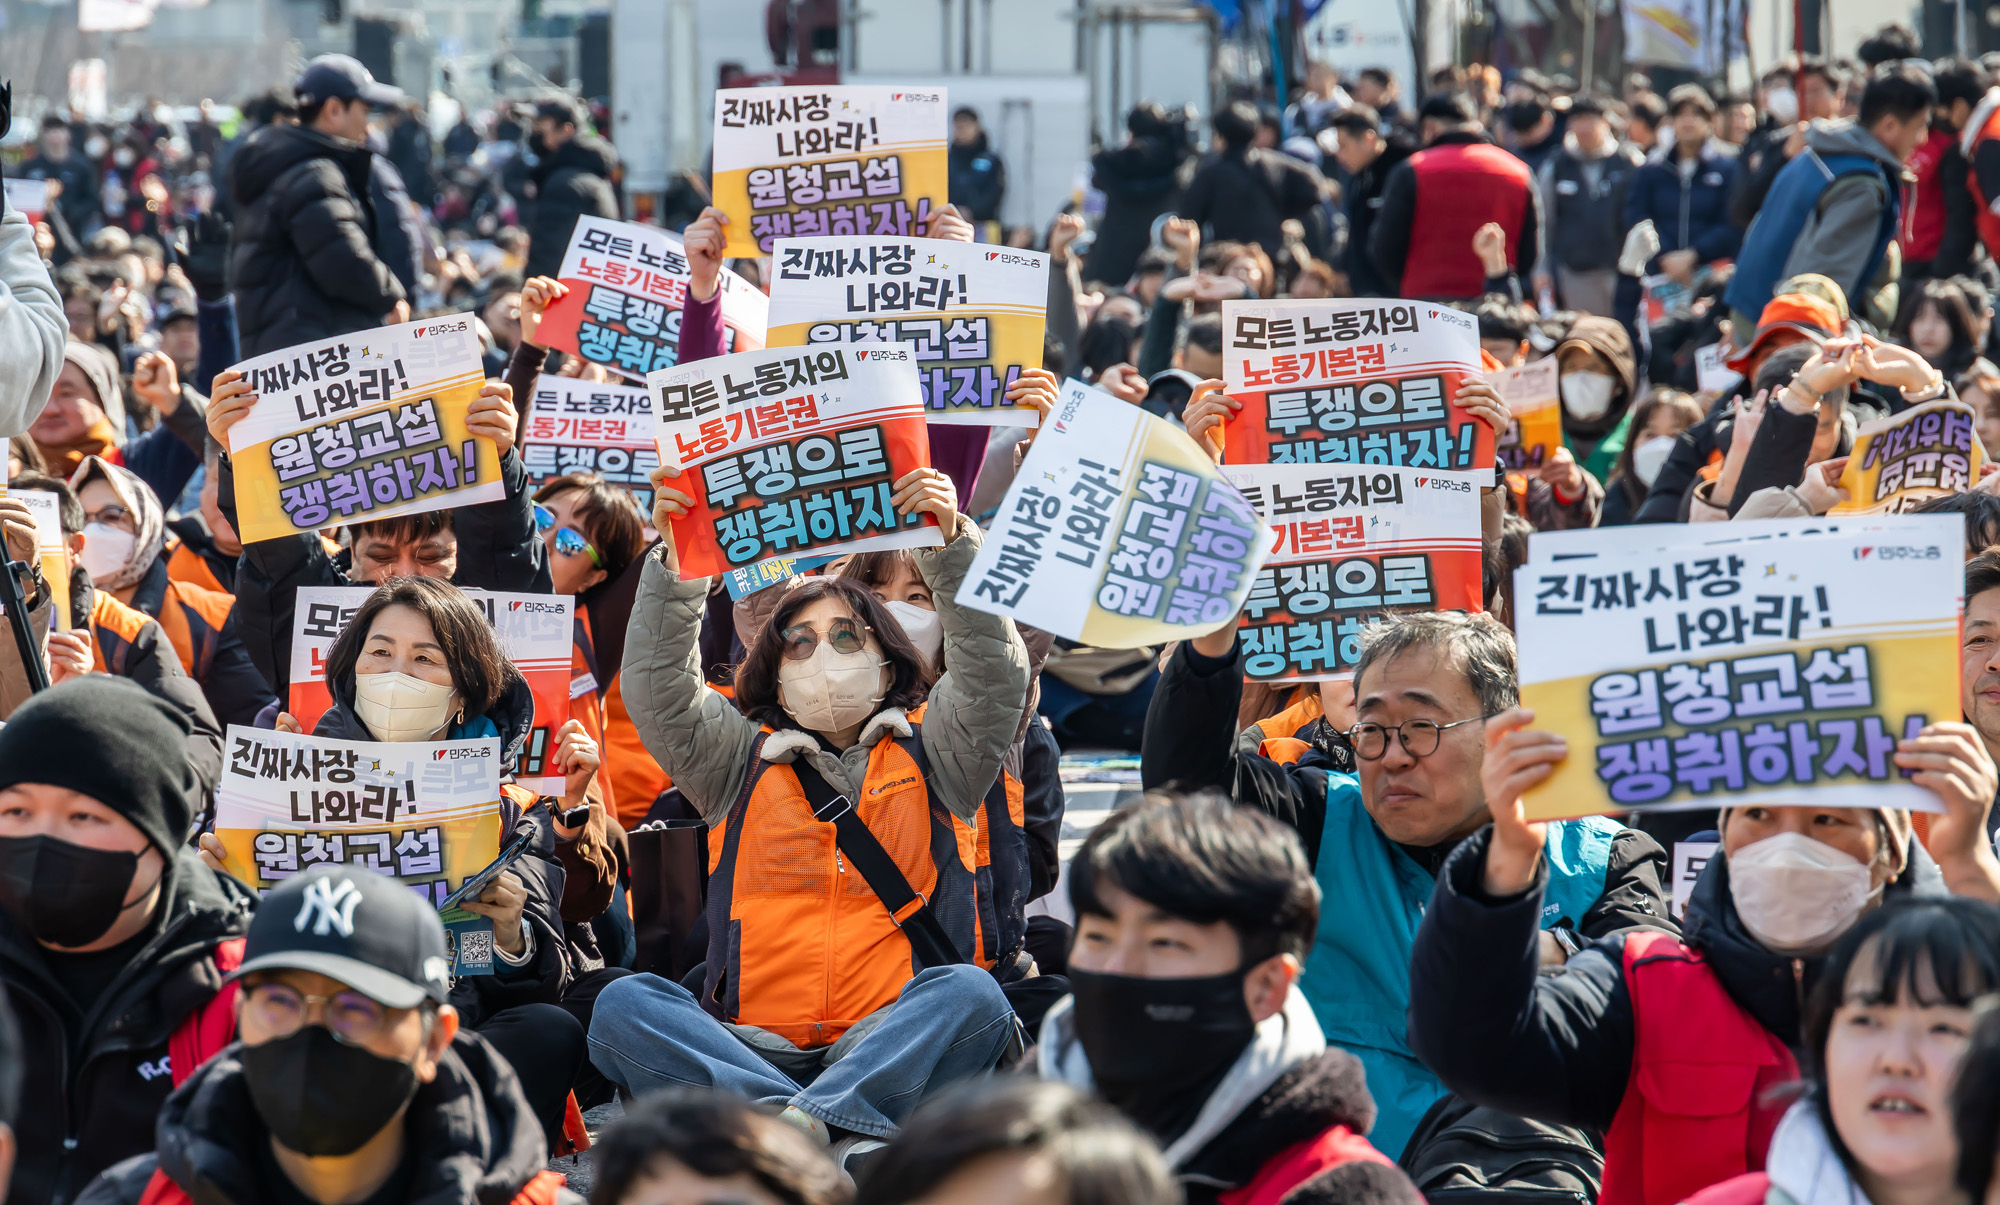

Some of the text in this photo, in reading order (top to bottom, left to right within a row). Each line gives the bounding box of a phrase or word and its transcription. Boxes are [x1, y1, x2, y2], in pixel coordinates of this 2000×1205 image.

[722, 93, 832, 128] 진짜사장
[904, 93, 940, 103] 민주노총
[777, 117, 880, 157] 나와라!
[747, 155, 900, 209] 원청교섭
[577, 227, 634, 261] 모든
[780, 244, 916, 280] 진짜사장
[1000, 252, 1041, 269] 민주노총
[846, 274, 968, 313] 나와라!
[428, 321, 467, 337] 민주노총
[1232, 305, 1420, 350] 모든 노동자의
[1440, 311, 1472, 330] 민주노총
[870, 350, 908, 362] 민주노총
[1242, 342, 1387, 388] 노동기본권
[295, 358, 410, 422] 나와라!
[534, 391, 558, 411] 든
[661, 348, 849, 423] 모든 노동자의
[1059, 390, 1086, 423] 민주노총
[1265, 375, 1448, 436] 투쟁으로
[268, 397, 443, 484] 원청교섭
[674, 394, 821, 464] 노동기본권
[279, 438, 478, 528] 쟁취하자!
[700, 424, 890, 511] 투쟁으로
[1431, 478, 1471, 493] 민주노총
[1055, 457, 1123, 569] 나와라!
[1272, 472, 1404, 515] 노동자의
[973, 485, 1062, 609] 진짜사장
[1098, 460, 1200, 619] 원청교섭
[1270, 515, 1367, 555] 기본권
[1878, 545, 1941, 561] 민주노총
[524, 600, 566, 614] 민주노총
[1535, 554, 1746, 616] 진짜사장
[1644, 585, 1833, 655] 나와라!
[1589, 644, 1874, 737] 원청교섭
[230, 736, 359, 784] 진짜사장
[449, 746, 491, 760] 민주노총
[290, 780, 417, 824] 나와라!
[293, 875, 364, 938] NY
